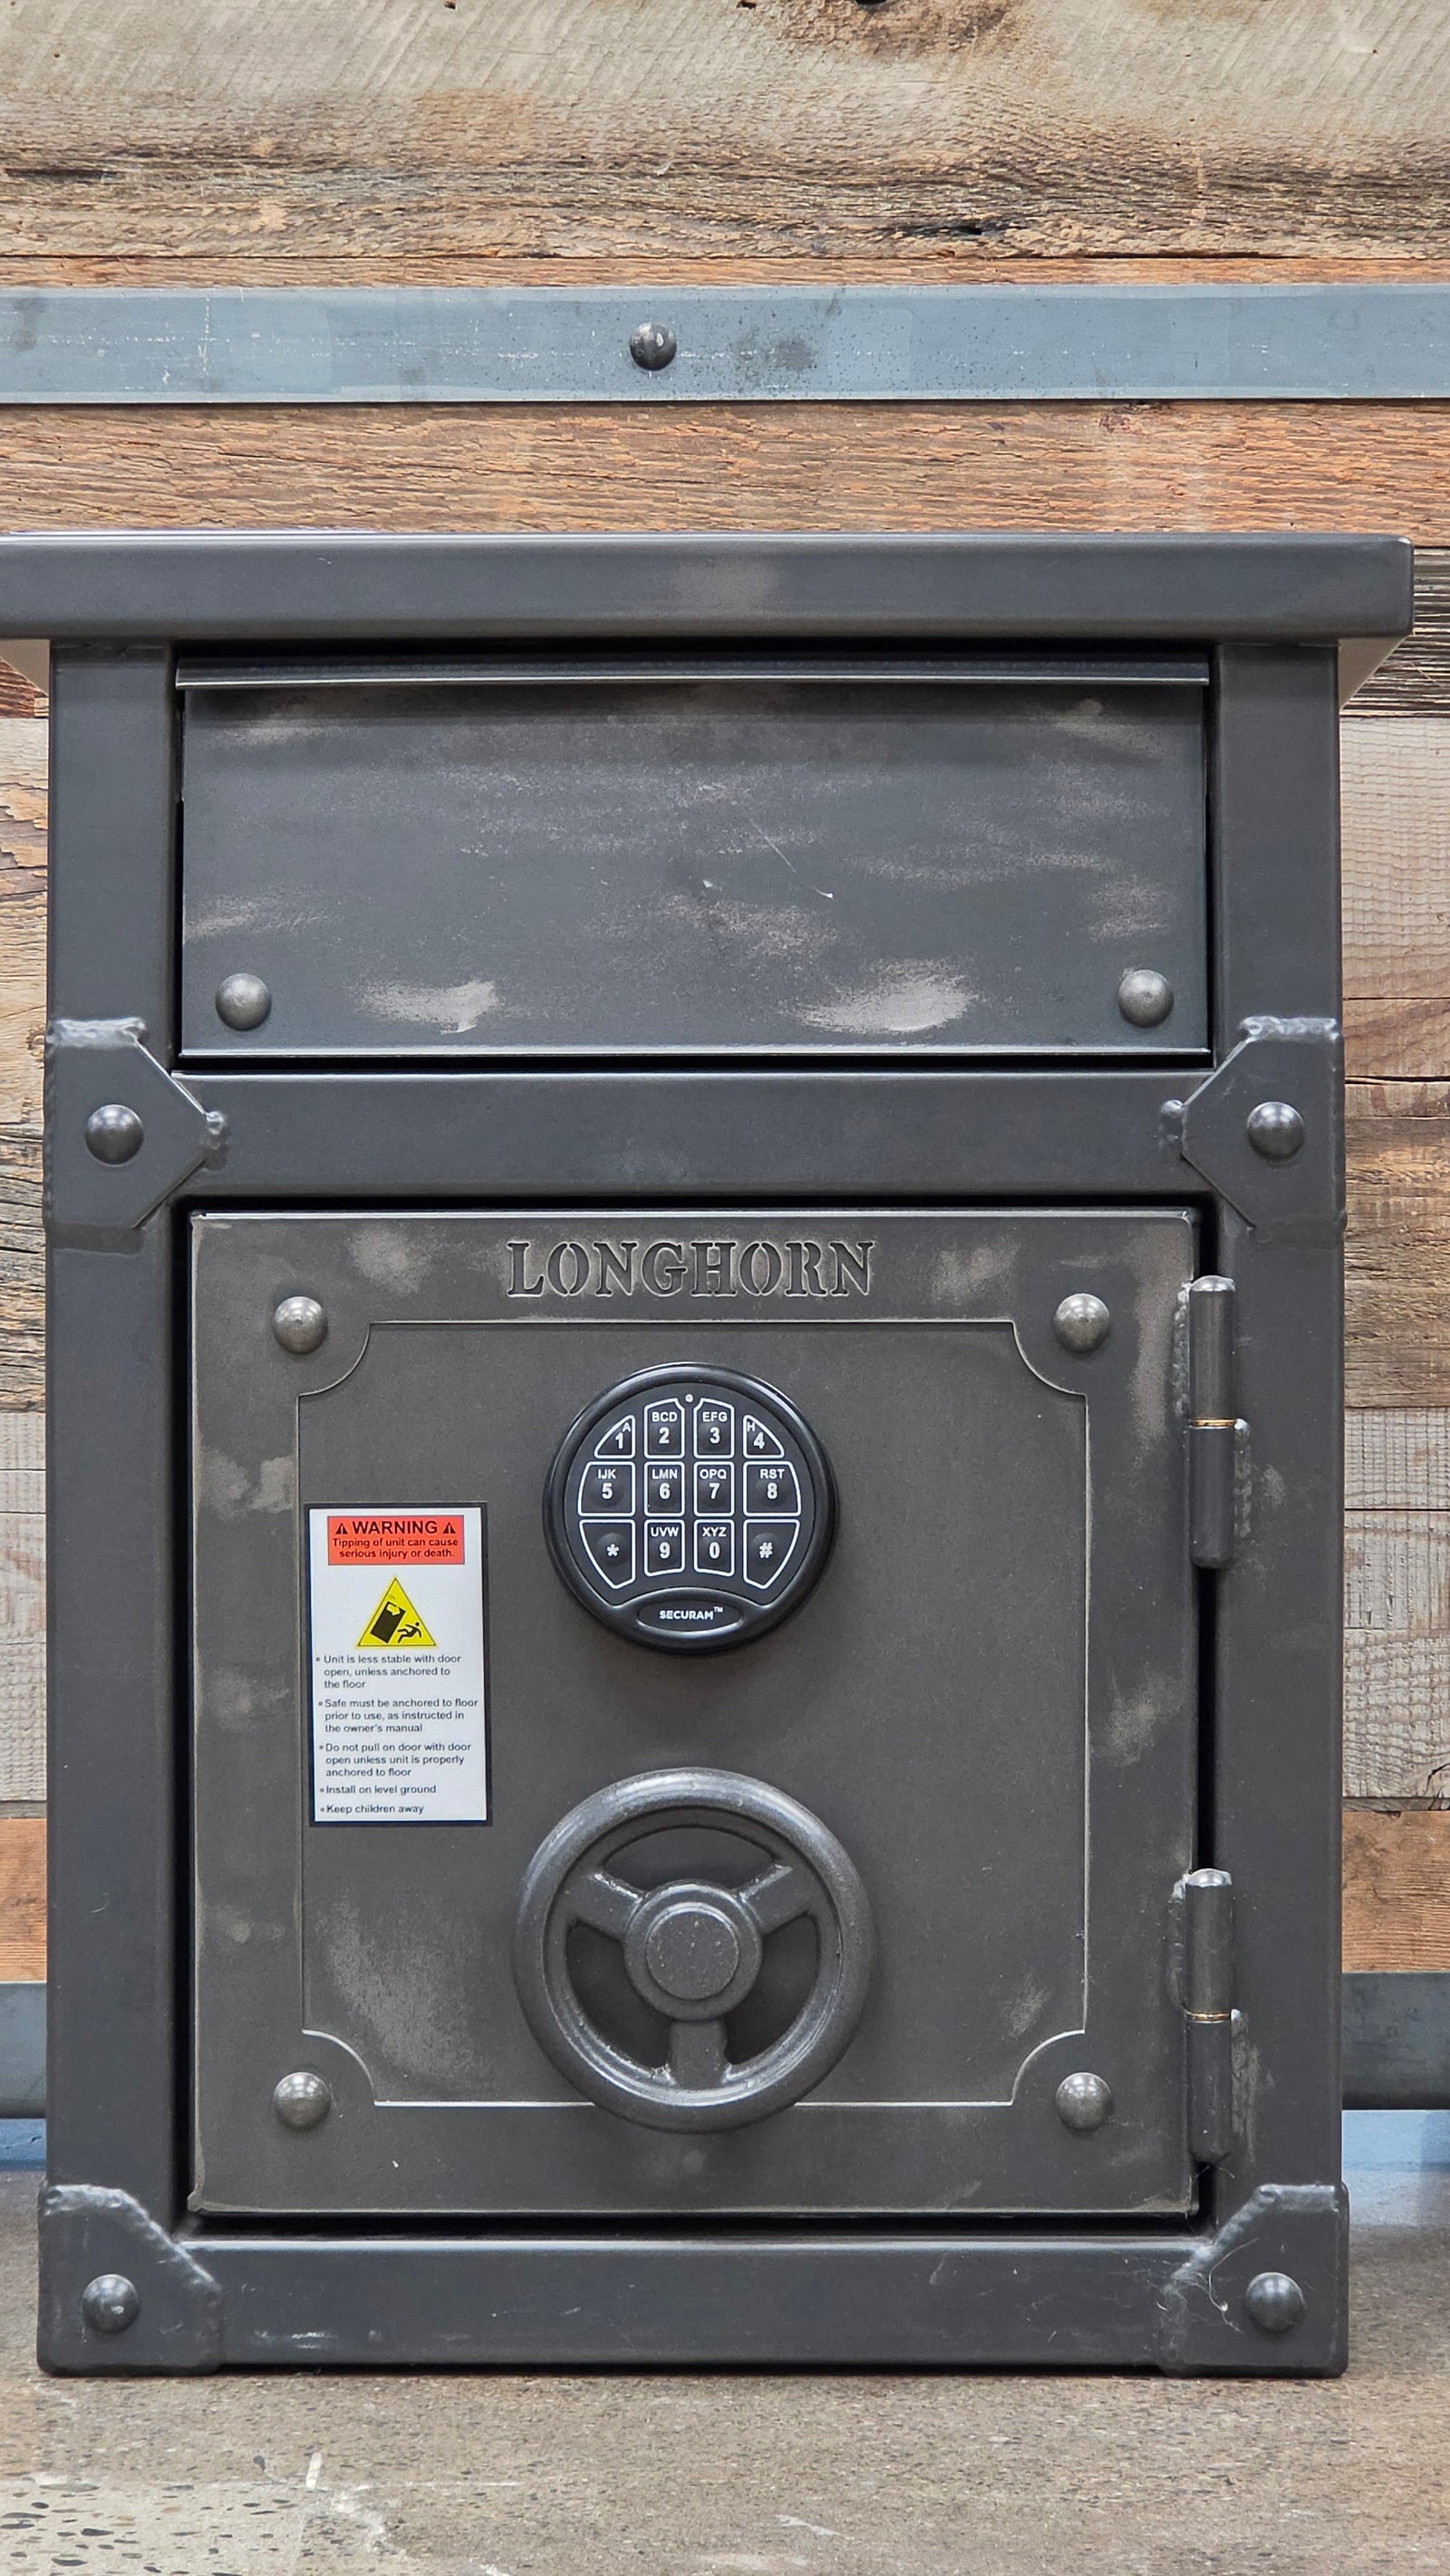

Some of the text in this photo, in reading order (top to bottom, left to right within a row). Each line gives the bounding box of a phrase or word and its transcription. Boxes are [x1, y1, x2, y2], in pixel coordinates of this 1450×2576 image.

[506, 1241, 875, 1297] LONGHORN
[652, 1412, 677, 1422] BCD
[702, 1412, 728, 1422] EFG
[623, 1422, 631, 1432] A
[747, 1422, 755, 1431] H
[615, 1432, 624, 1449] 1
[659, 1428, 670, 1444] 2
[710, 1428, 720, 1443] 3
[754, 1432, 765, 1449] 4
[598, 1469, 616, 1479] IJK
[652, 1469, 677, 1479] LMN
[700, 1469, 727, 1479] OPQ
[760, 1469, 785, 1478] RST
[602, 1483, 613, 1499] 5
[660, 1483, 671, 1499] 6
[710, 1483, 720, 1499] 7
[768, 1483, 778, 1499] 8
[353, 1521, 438, 1535] WARNING
[651, 1527, 679, 1536] UVW
[702, 1527, 727, 1536] XYZ
[333, 1538, 370, 1548] Tipping
[373, 1537, 383, 1546] of
[386, 1538, 404, 1546] unit
[339, 1549, 376, 1557] serious
[380, 1549, 407, 1559] injury
[424, 1549, 455, 1557] death.
[660, 1542, 671, 1559] 9
[710, 1542, 720, 1559] 0
[324, 1655, 343, 1664] Unit
[347, 1655, 355, 1663] is
[358, 1655, 378, 1663] less
[382, 1655, 411, 1663] stable
[438, 1654, 461, 1662] door
[324, 1669, 353, 1677] open,
[355, 1668, 387, 1676] unless
[391, 1667, 437, 1675] anchored
[324, 1680, 365, 1689] the floor
[325, 1699, 346, 1707] Safe
[378, 1699, 389, 1707] be
[392, 1699, 439, 1707] anchored
[442, 1699, 452, 1707] to
[455, 1699, 478, 1707] floor
[325, 1712, 348, 1721] prior
[364, 1713, 385, 1721] use,
[402, 1711, 452, 1719] instructed
[455, 1711, 464, 1719] in
[325, 1724, 340, 1732] the
[386, 1724, 422, 1732] manual
[325, 1743, 339, 1751] Do
[362, 1743, 379, 1753] pull
[399, 1743, 420, 1751] door
[424, 1743, 445, 1751] with
[326, 1758, 351, 1766] open
[353, 1756, 386, 1764] unless
[390, 1756, 408, 1764] unit
[423, 1756, 465, 1766] properly
[326, 1768, 372, 1777] anchored
[376, 1768, 385, 1777] to
[326, 1786, 355, 1794] Install
[374, 1785, 397, 1793] level
[401, 1786, 436, 1796] ground
[326, 1805, 424, 1814] Keep children away
